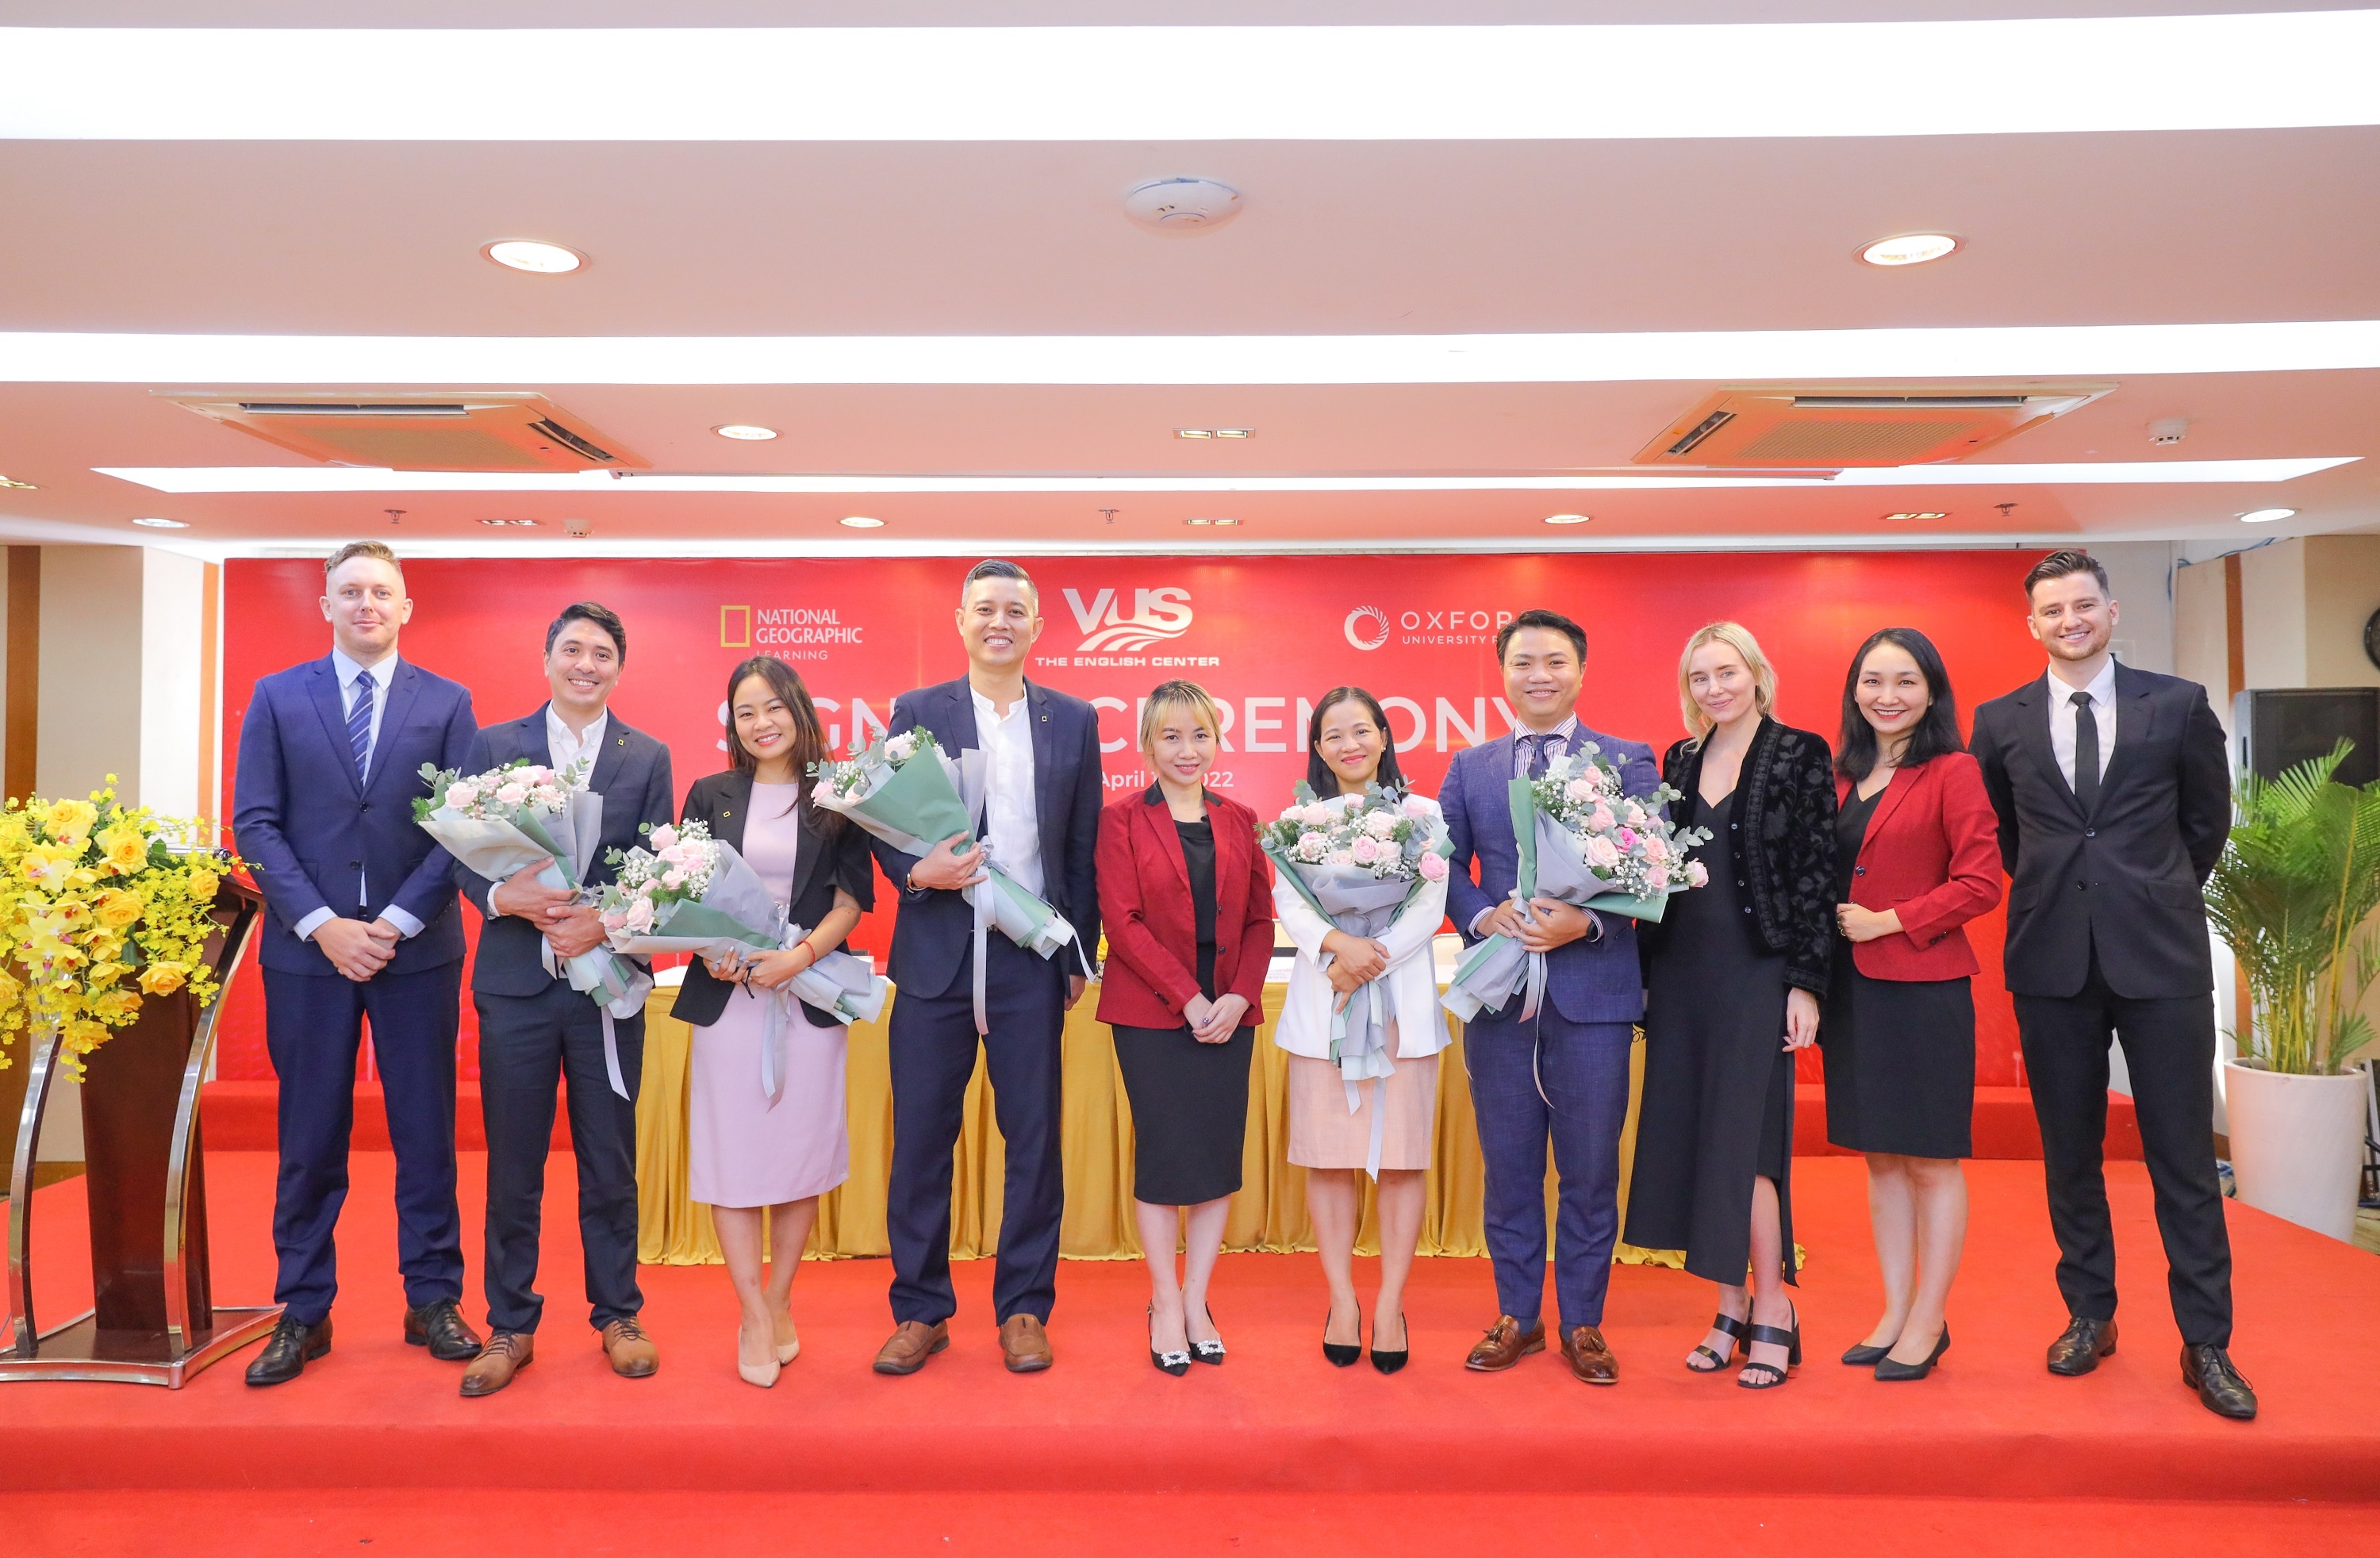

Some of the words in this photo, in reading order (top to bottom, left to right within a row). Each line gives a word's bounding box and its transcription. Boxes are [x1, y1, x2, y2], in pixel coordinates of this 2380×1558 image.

[757, 608, 841, 625] NATIONAL
[1061, 586, 1193, 635] VUS
[1400, 610, 1513, 631] OXFOR
[755, 627, 863, 644] GEOGRAPHIC
[1402, 635, 1487, 645] UNIVERSITY
[1035, 657, 1068, 666] THE
[1073, 657, 1146, 666] ENGLISH
[1151, 656, 1219, 666] CENTER
[1102, 769, 1145, 792] April
